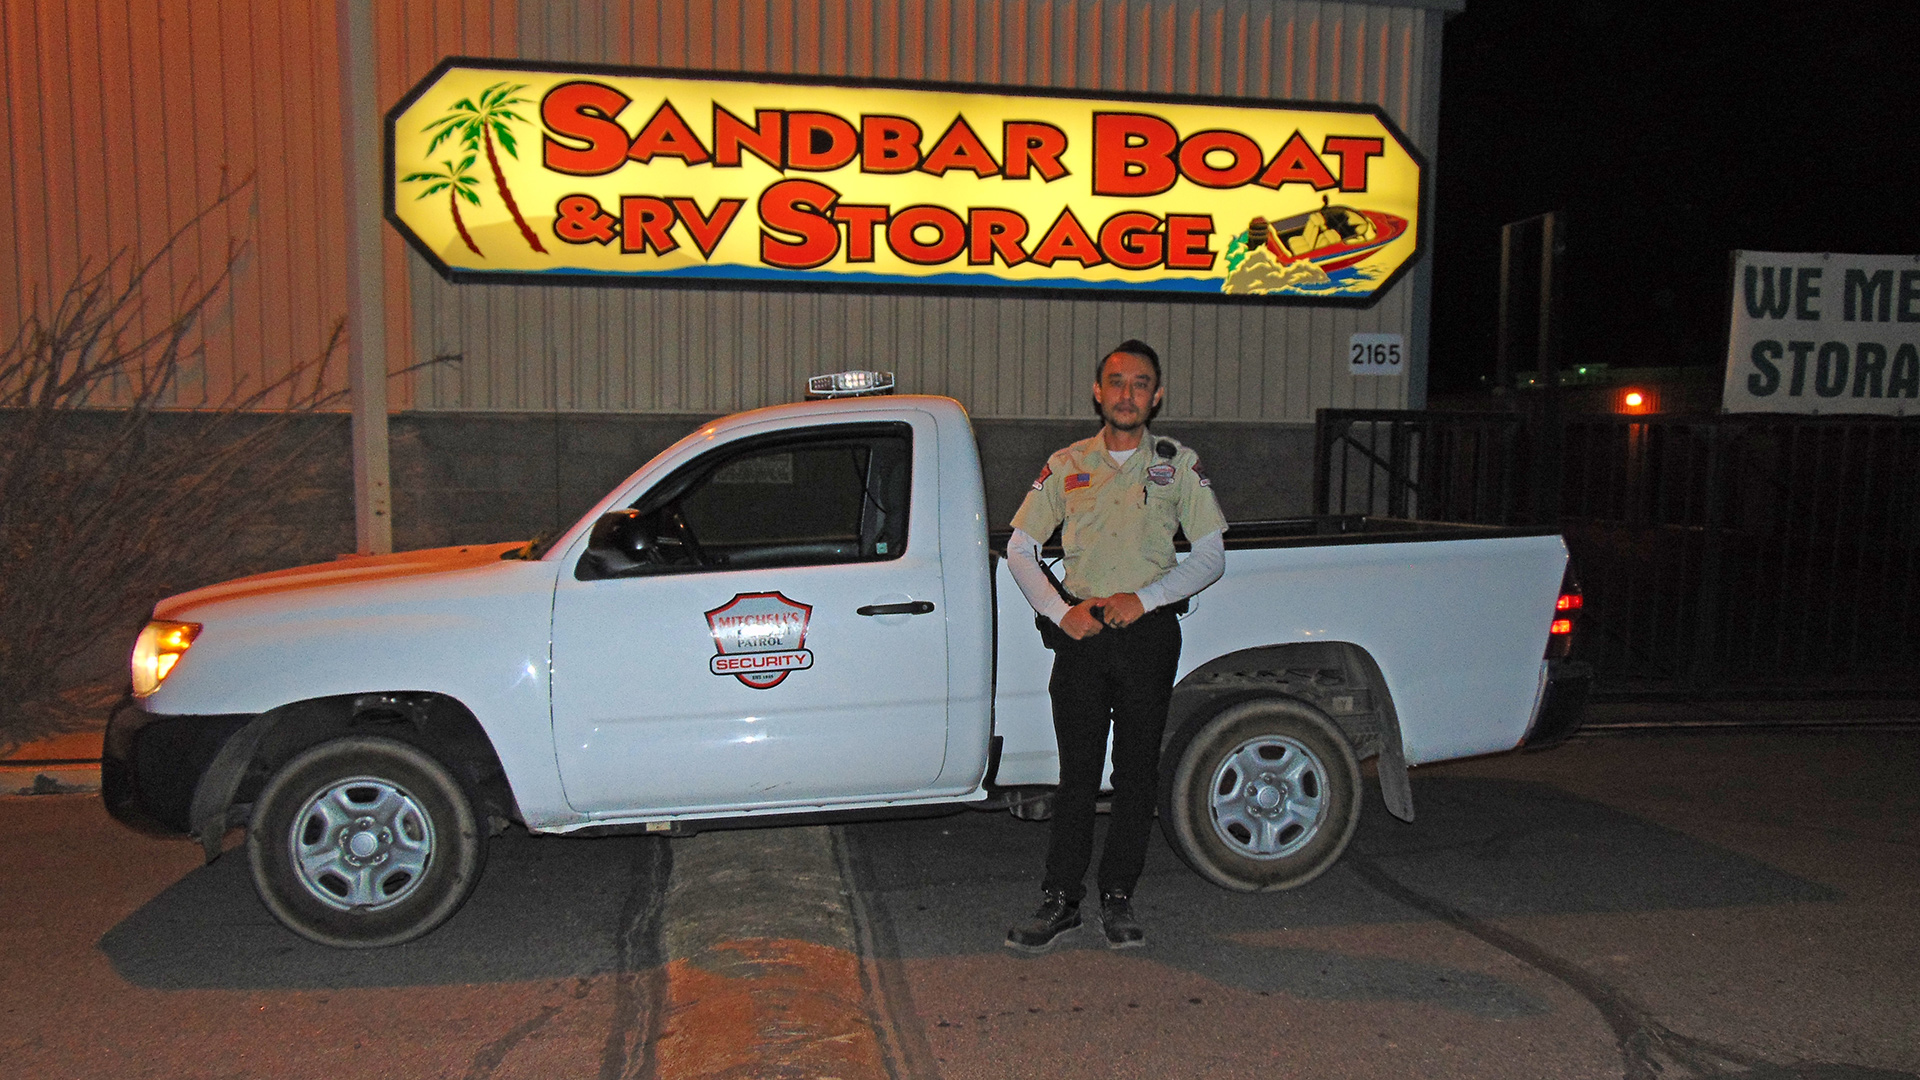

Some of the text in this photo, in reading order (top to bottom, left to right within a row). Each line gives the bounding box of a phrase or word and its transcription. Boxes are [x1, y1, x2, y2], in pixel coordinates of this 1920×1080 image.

[540, 80, 1385, 197] SANDBAR BOAT
[757, 178, 1217, 271] STORAGE
[1744, 266, 1822, 320] WE
[1352, 343, 1400, 364] 2165
[737, 637, 783, 648] PATROL
[716, 654, 806, 671] SECURITY
